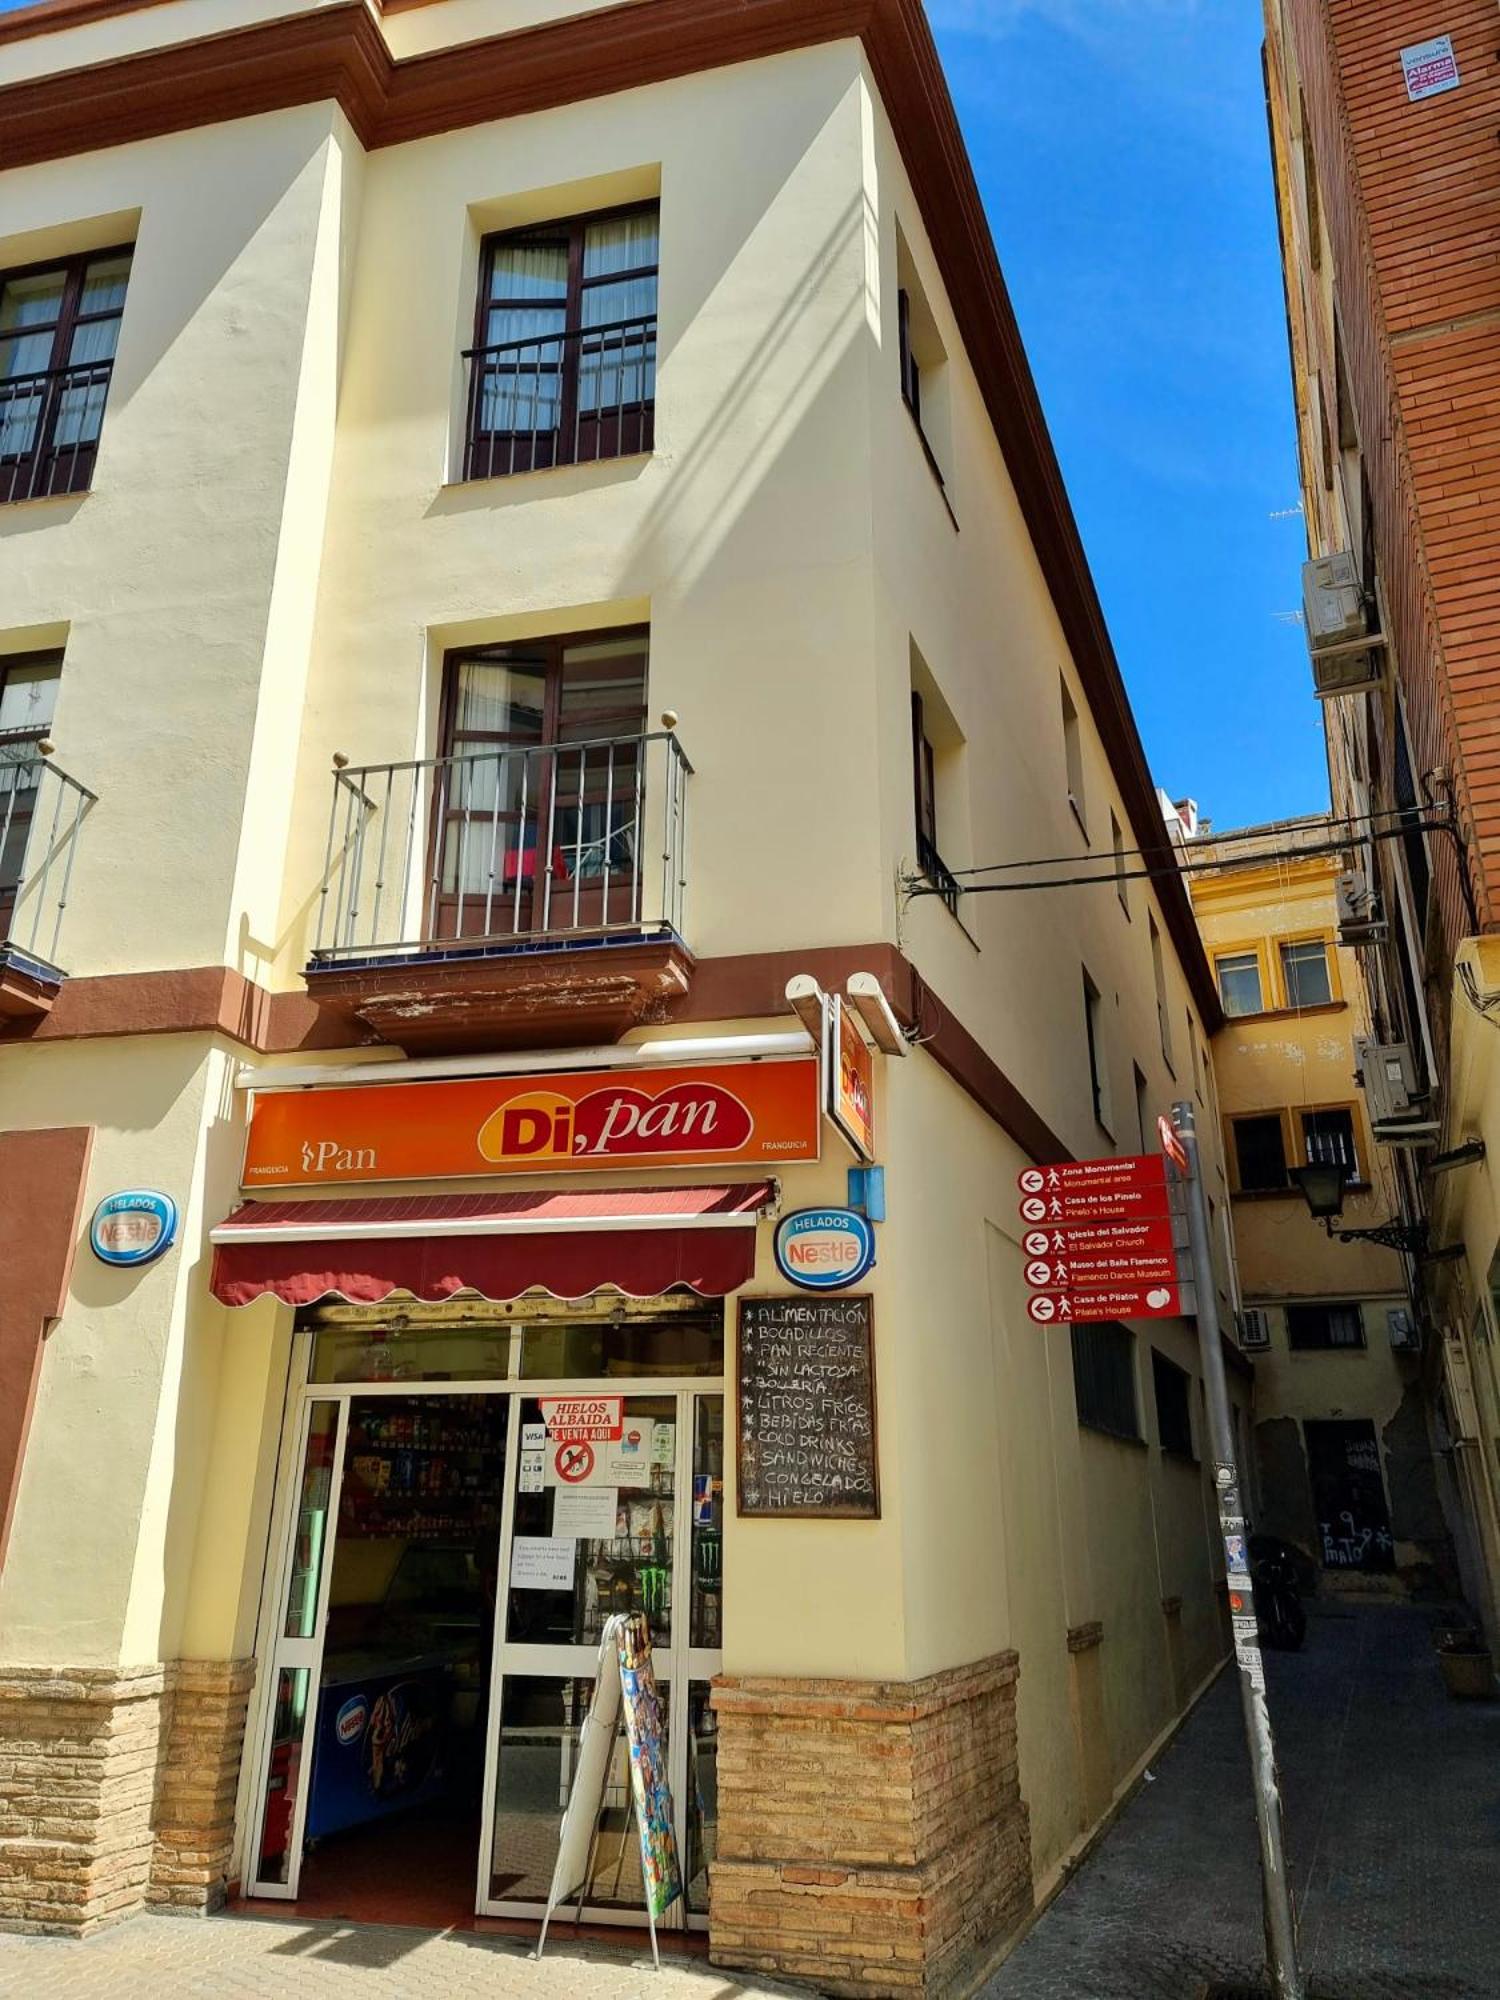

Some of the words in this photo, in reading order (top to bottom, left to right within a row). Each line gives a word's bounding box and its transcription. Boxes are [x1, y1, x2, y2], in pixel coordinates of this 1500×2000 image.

[1409, 59, 1452, 77] Alarma
[762, 1141, 806, 1151] FRANQUICIA
[1063, 1166, 1083, 1177] Zona
[1085, 1162, 1136, 1175] Monumental
[1065, 1195, 1086, 1205] Casa
[1087, 1194, 1098, 1203] de
[1100, 1193, 1112, 1203] los
[1114, 1191, 1141, 1202] Pinelo
[1100, 1205, 1124, 1216] House
[795, 1216, 849, 1230] HELADOS
[1068, 1227, 1095, 1241] Iglesia
[1096, 1226, 1110, 1237] del
[1111, 1225, 1149, 1236] Salvador
[1069, 1241, 1078, 1251] El
[1079, 1239, 1113, 1251] Salvador
[1115, 1237, 1145, 1248] Church
[1070, 1259, 1095, 1269] Museo
[1096, 1258, 1110, 1268] del
[1130, 1256, 1168, 1267] Flamenco
[1071, 1271, 1109, 1283] Flamenco
[1110, 1270, 1136, 1280] Dance
[1137, 1268, 1171, 1279] Museum
[1073, 1295, 1095, 1305] Casa
[1096, 1293, 1107, 1303] de
[1109, 1292, 1139, 1302] Pilatos
[1105, 1305, 1131, 1315] House
[761, 1343, 792, 1357] PAN
[556, 1402, 608, 1414] HIELOS
[758, 1392, 815, 1410] LITROS
[822, 1395, 868, 1418] FRÍOS
[548, 1414, 612, 1426] ALBAIDA
[759, 1412, 824, 1432] BEBIDAS
[525, 1433, 544, 1441] VISA
[562, 1428, 589, 1440] VENTA
[800, 1434, 855, 1457] DRINKS
[765, 1472, 872, 1493] CONGELADOS
